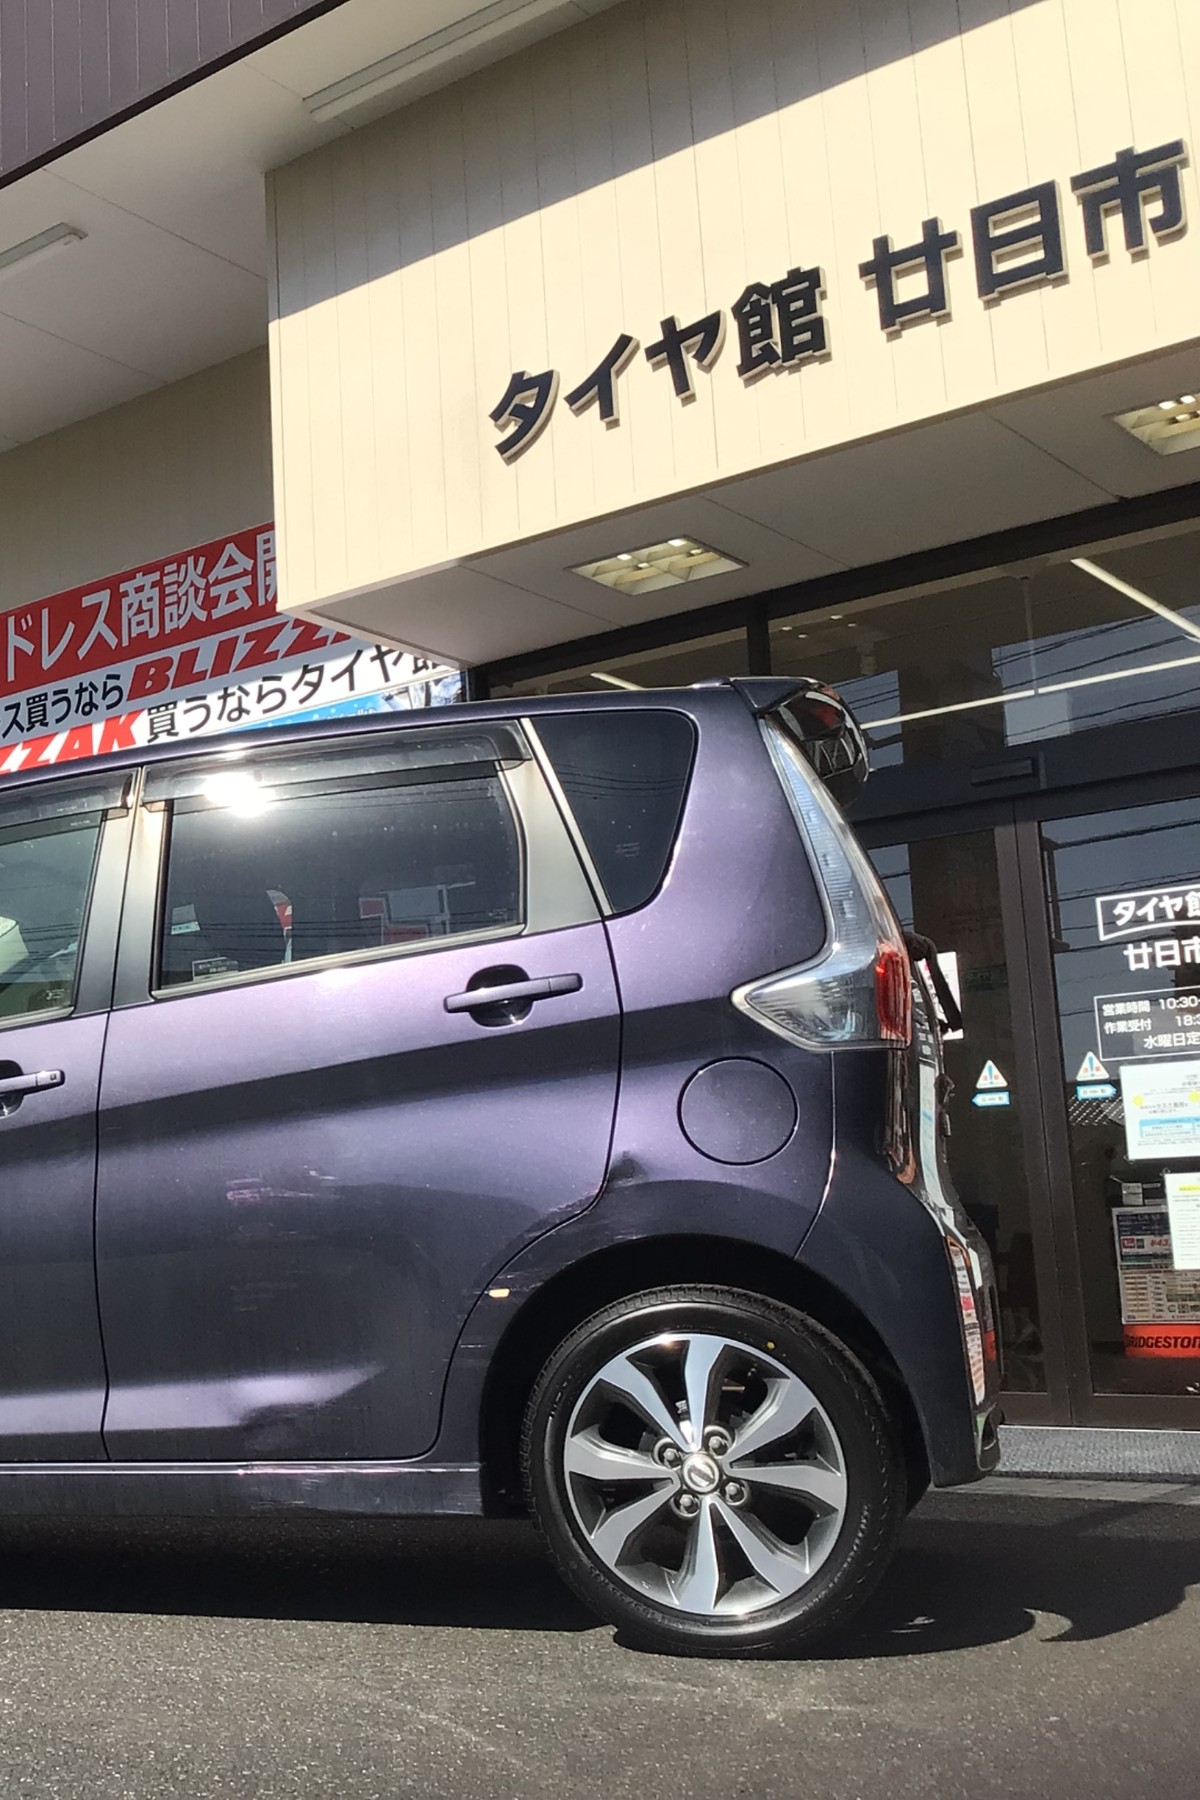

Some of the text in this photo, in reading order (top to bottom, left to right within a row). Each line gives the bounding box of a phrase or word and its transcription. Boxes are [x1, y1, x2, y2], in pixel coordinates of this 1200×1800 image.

[488, 139, 1188, 463] タイヤ館 廿日市
[127, 620, 352, 701] BLIZZ
[1102, 999, 1150, 1016] 営業時間
[1104, 1018, 1152, 1035] 作業受付
